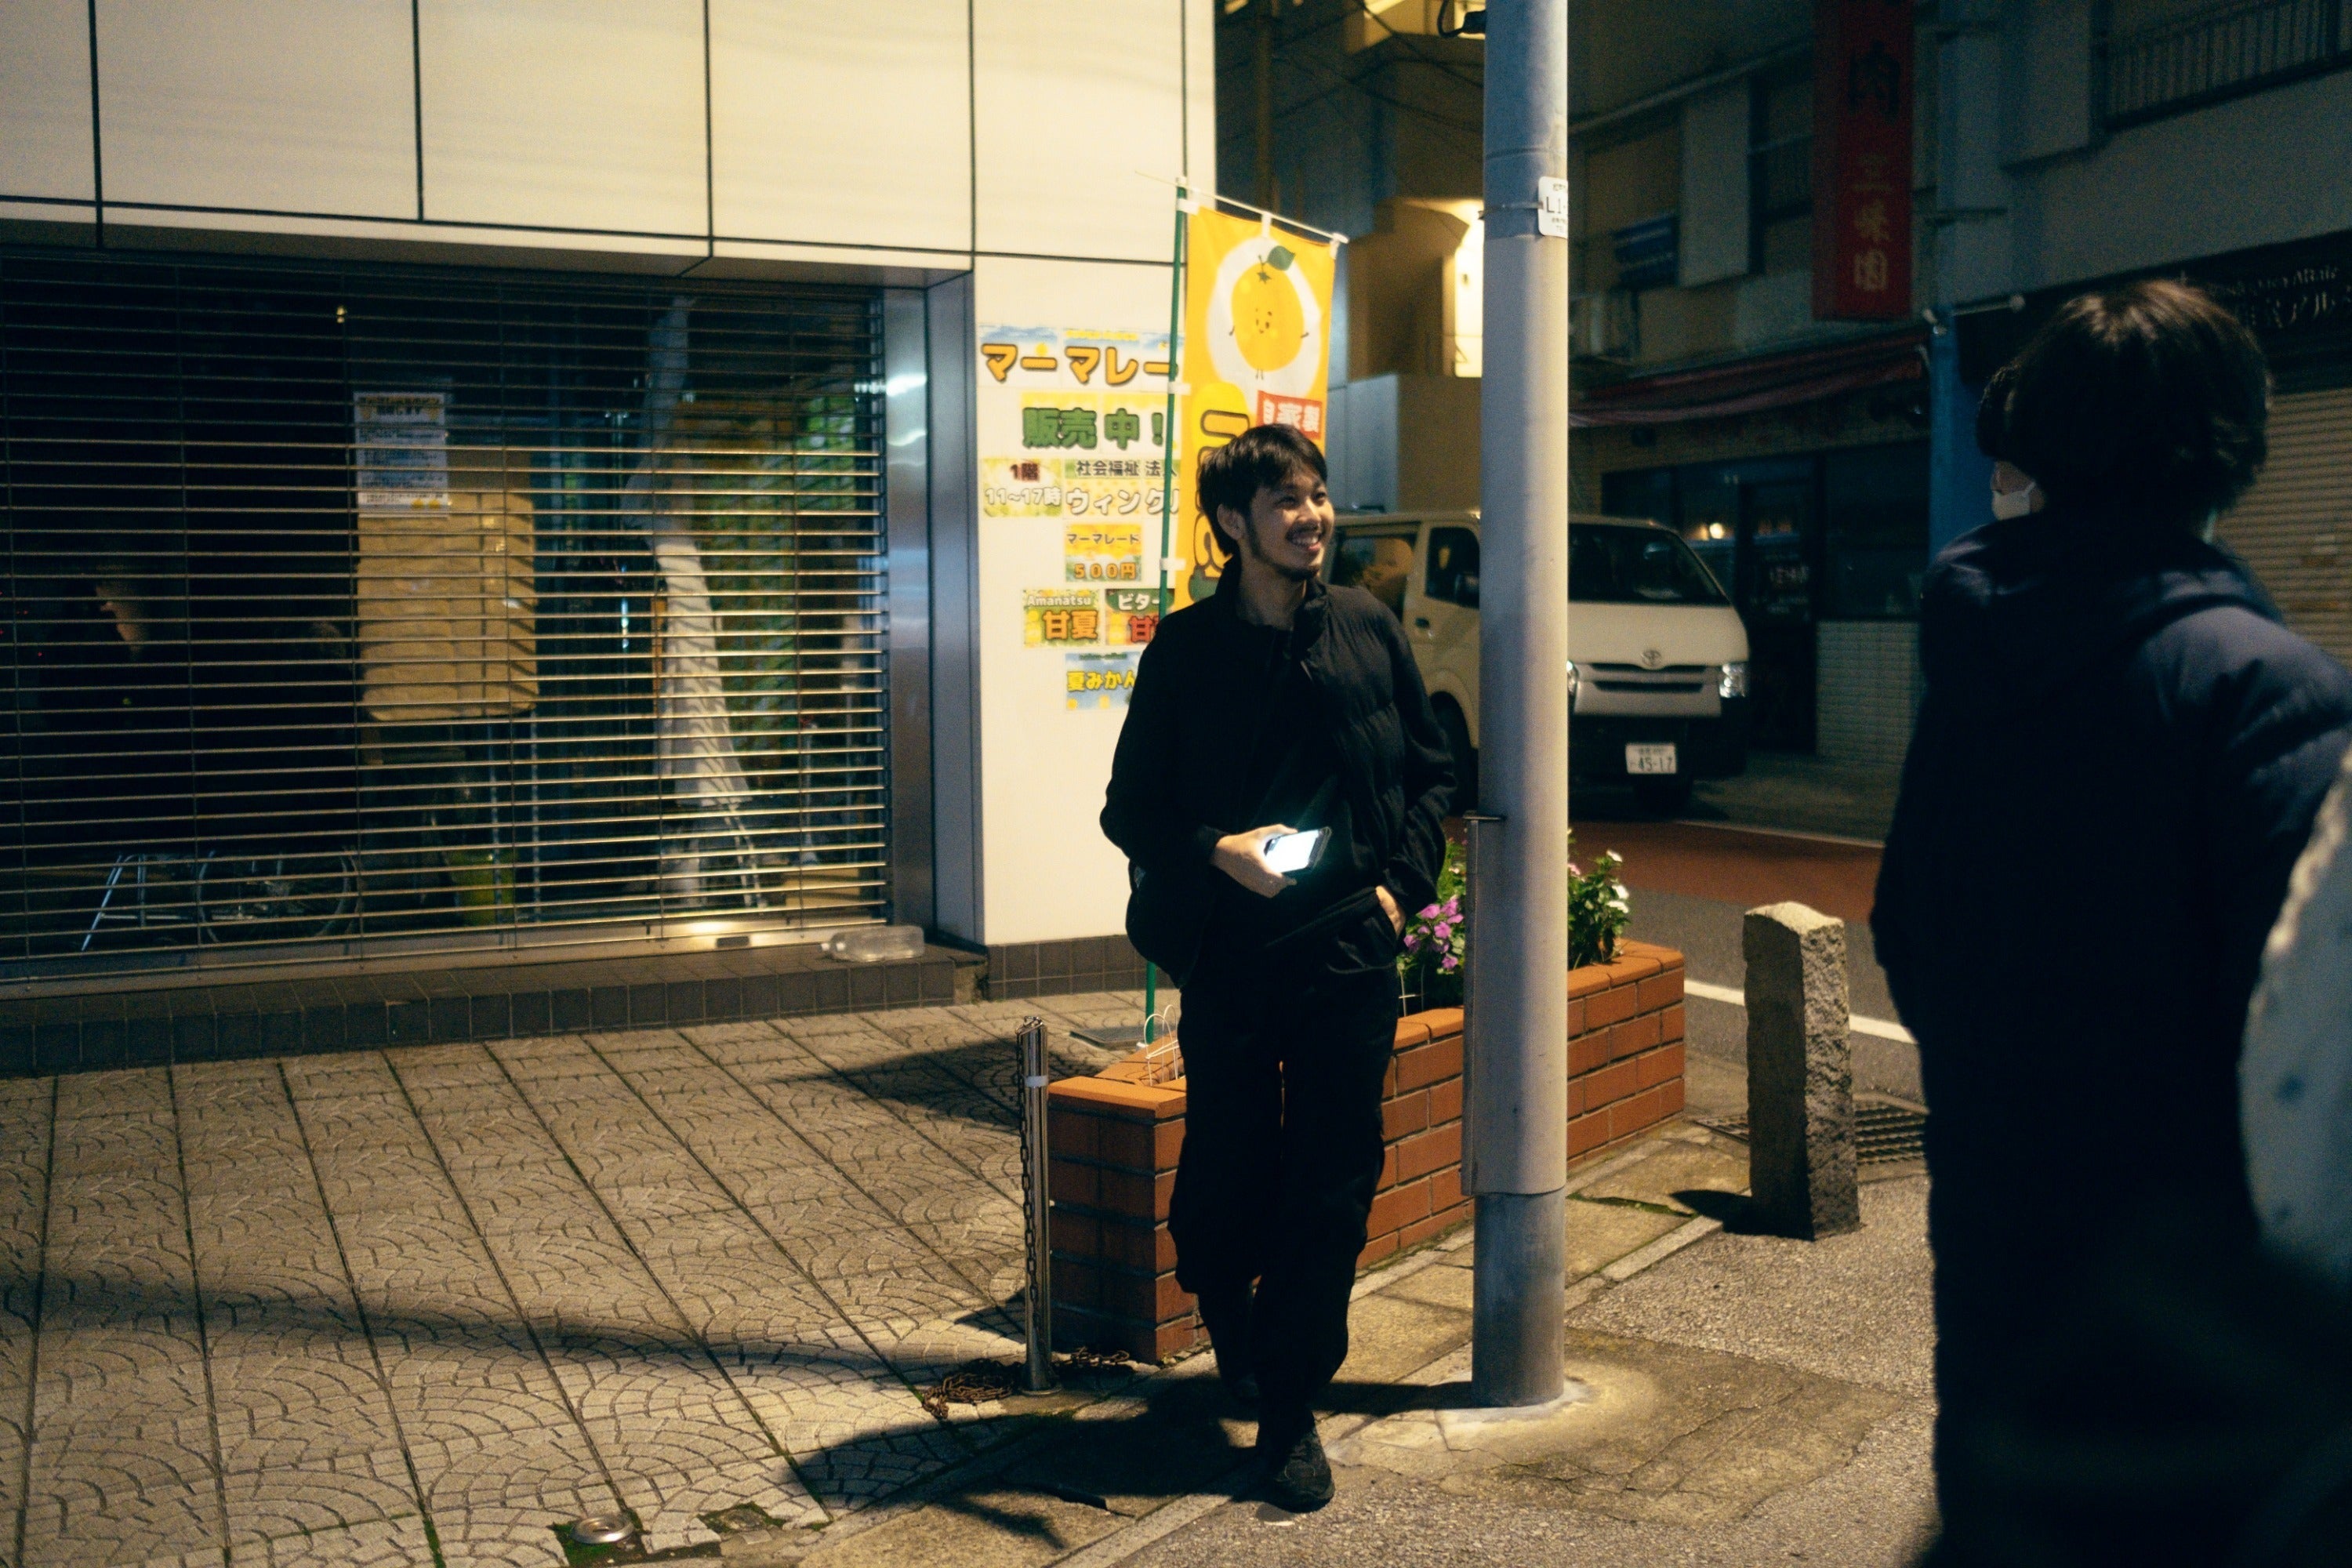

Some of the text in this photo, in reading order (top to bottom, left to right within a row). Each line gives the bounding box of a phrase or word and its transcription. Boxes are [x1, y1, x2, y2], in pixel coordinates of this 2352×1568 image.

[1066, 533, 1140, 545] マーマレード
[1026, 594, 1092, 607] Amanatsu
[1042, 608, 1099, 641] 甘夏
[1128, 615, 1160, 644] 甘
